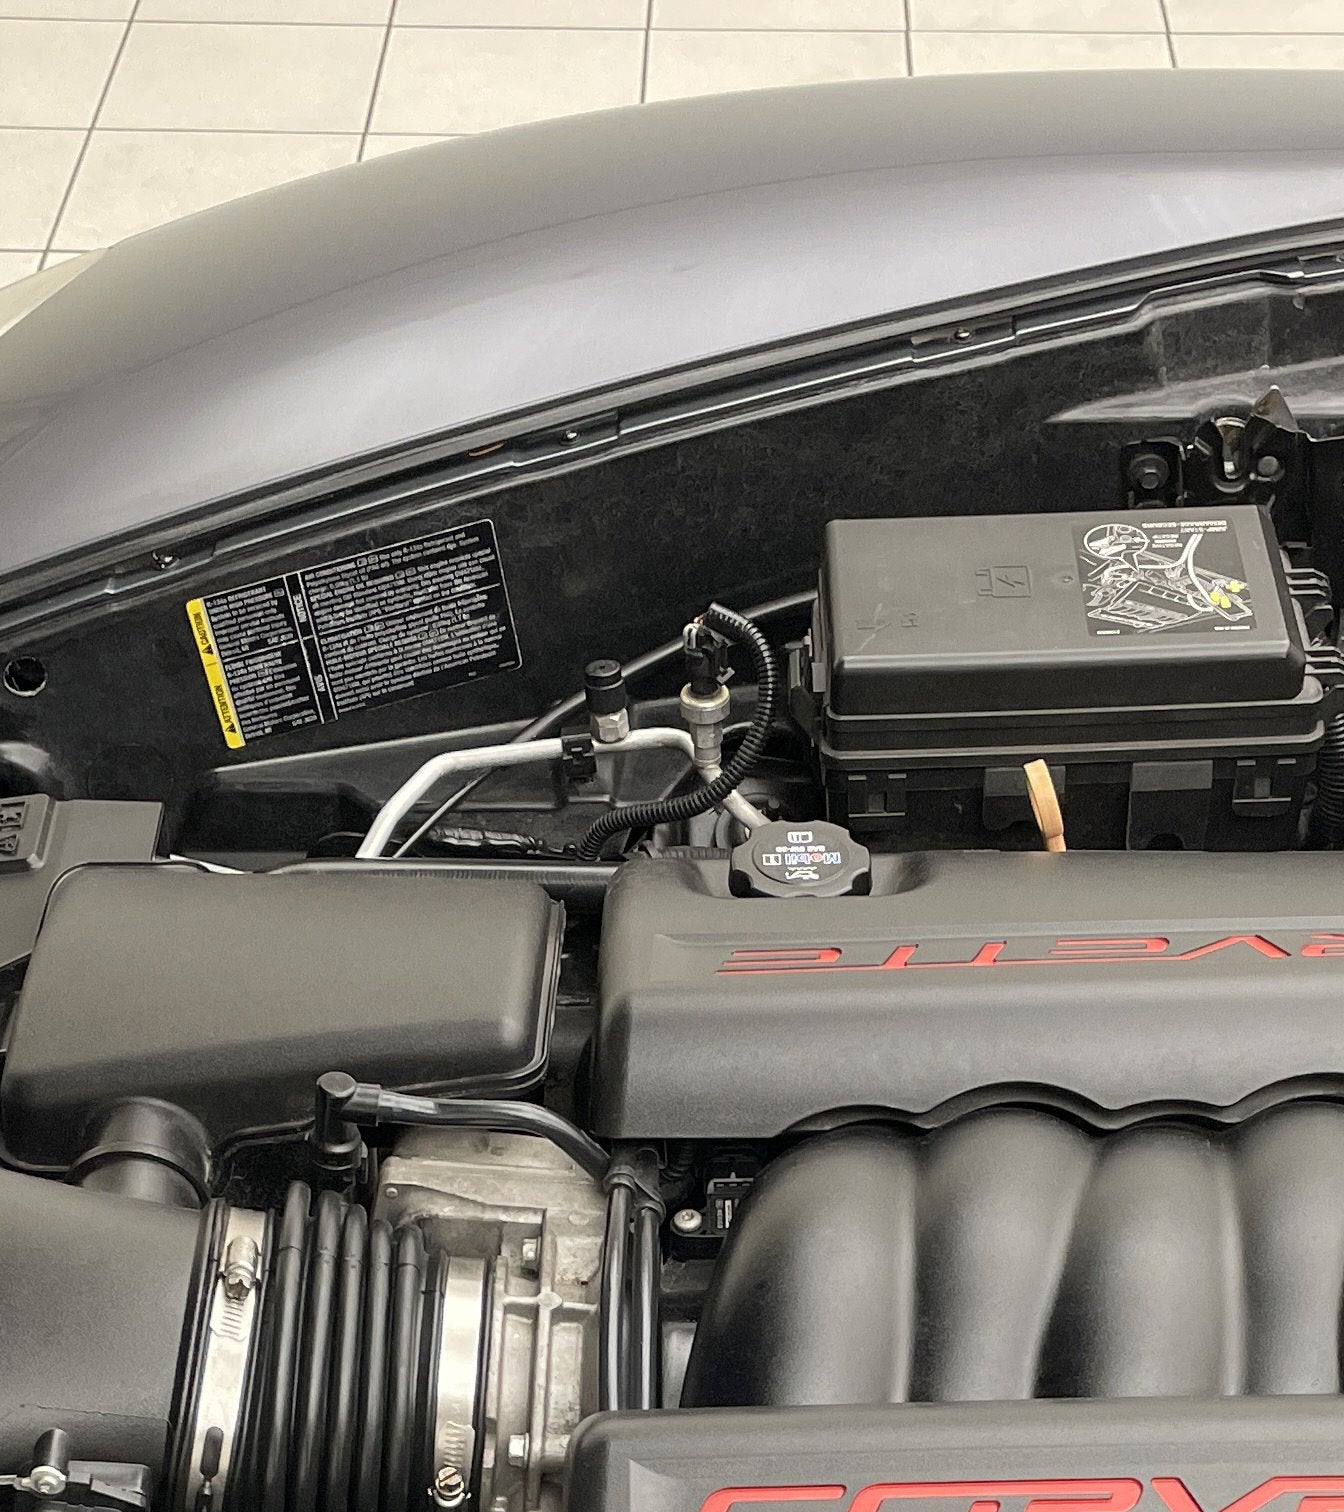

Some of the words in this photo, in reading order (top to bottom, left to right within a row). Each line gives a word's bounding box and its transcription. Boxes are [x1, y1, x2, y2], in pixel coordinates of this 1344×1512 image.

[193, 612, 209, 645] CAUTION
[214, 684, 233, 725] ATTENTION
[785, 852, 841, 865] Mobil
